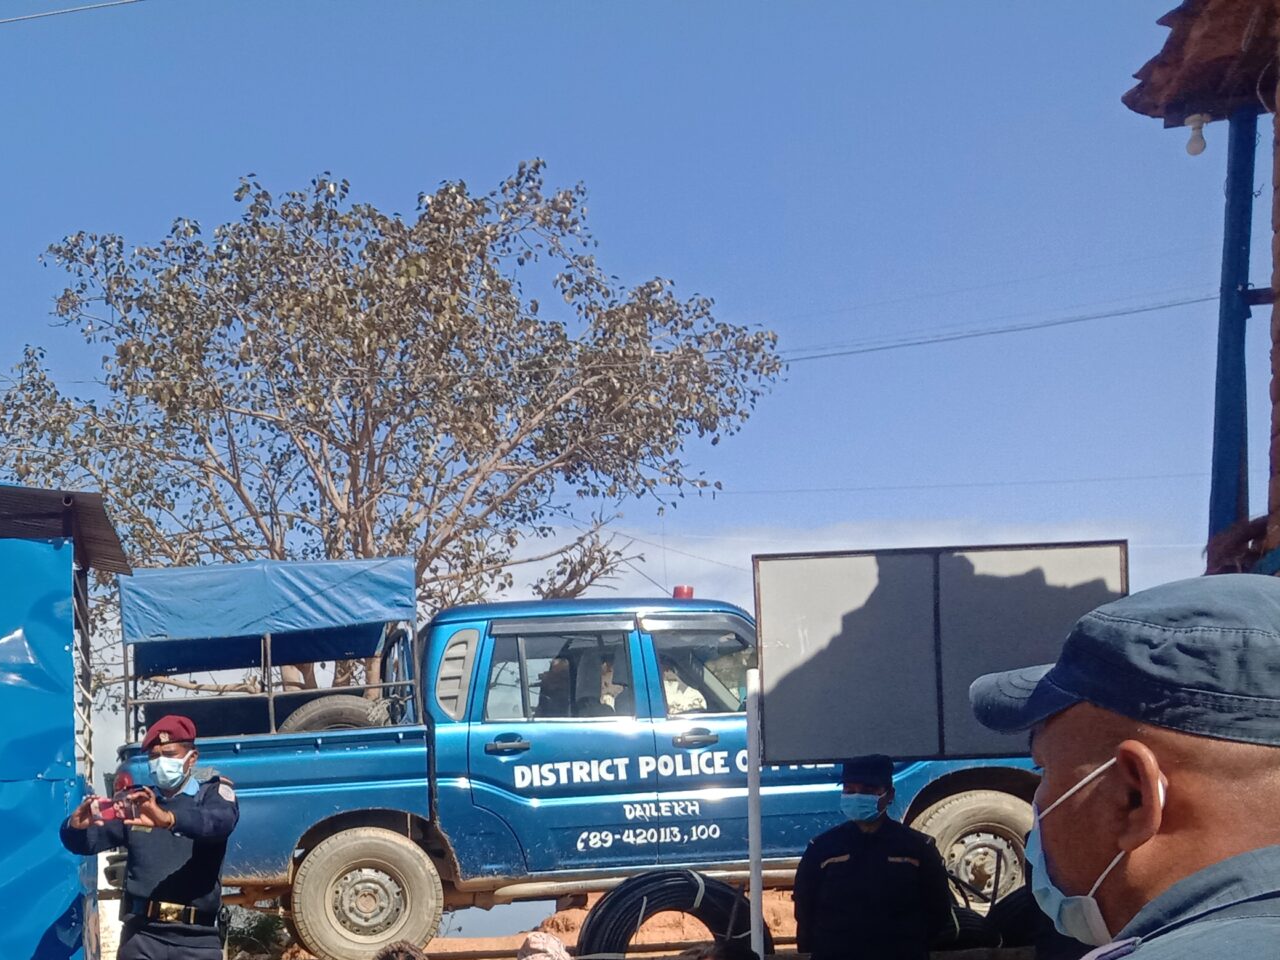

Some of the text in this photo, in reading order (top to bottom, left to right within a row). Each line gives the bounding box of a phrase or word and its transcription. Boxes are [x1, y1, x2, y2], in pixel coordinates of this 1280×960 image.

[514, 757, 629, 789] DISTRICT
[639, 751, 730, 779] POLICE
[623, 800, 700, 822] DAILEKH
